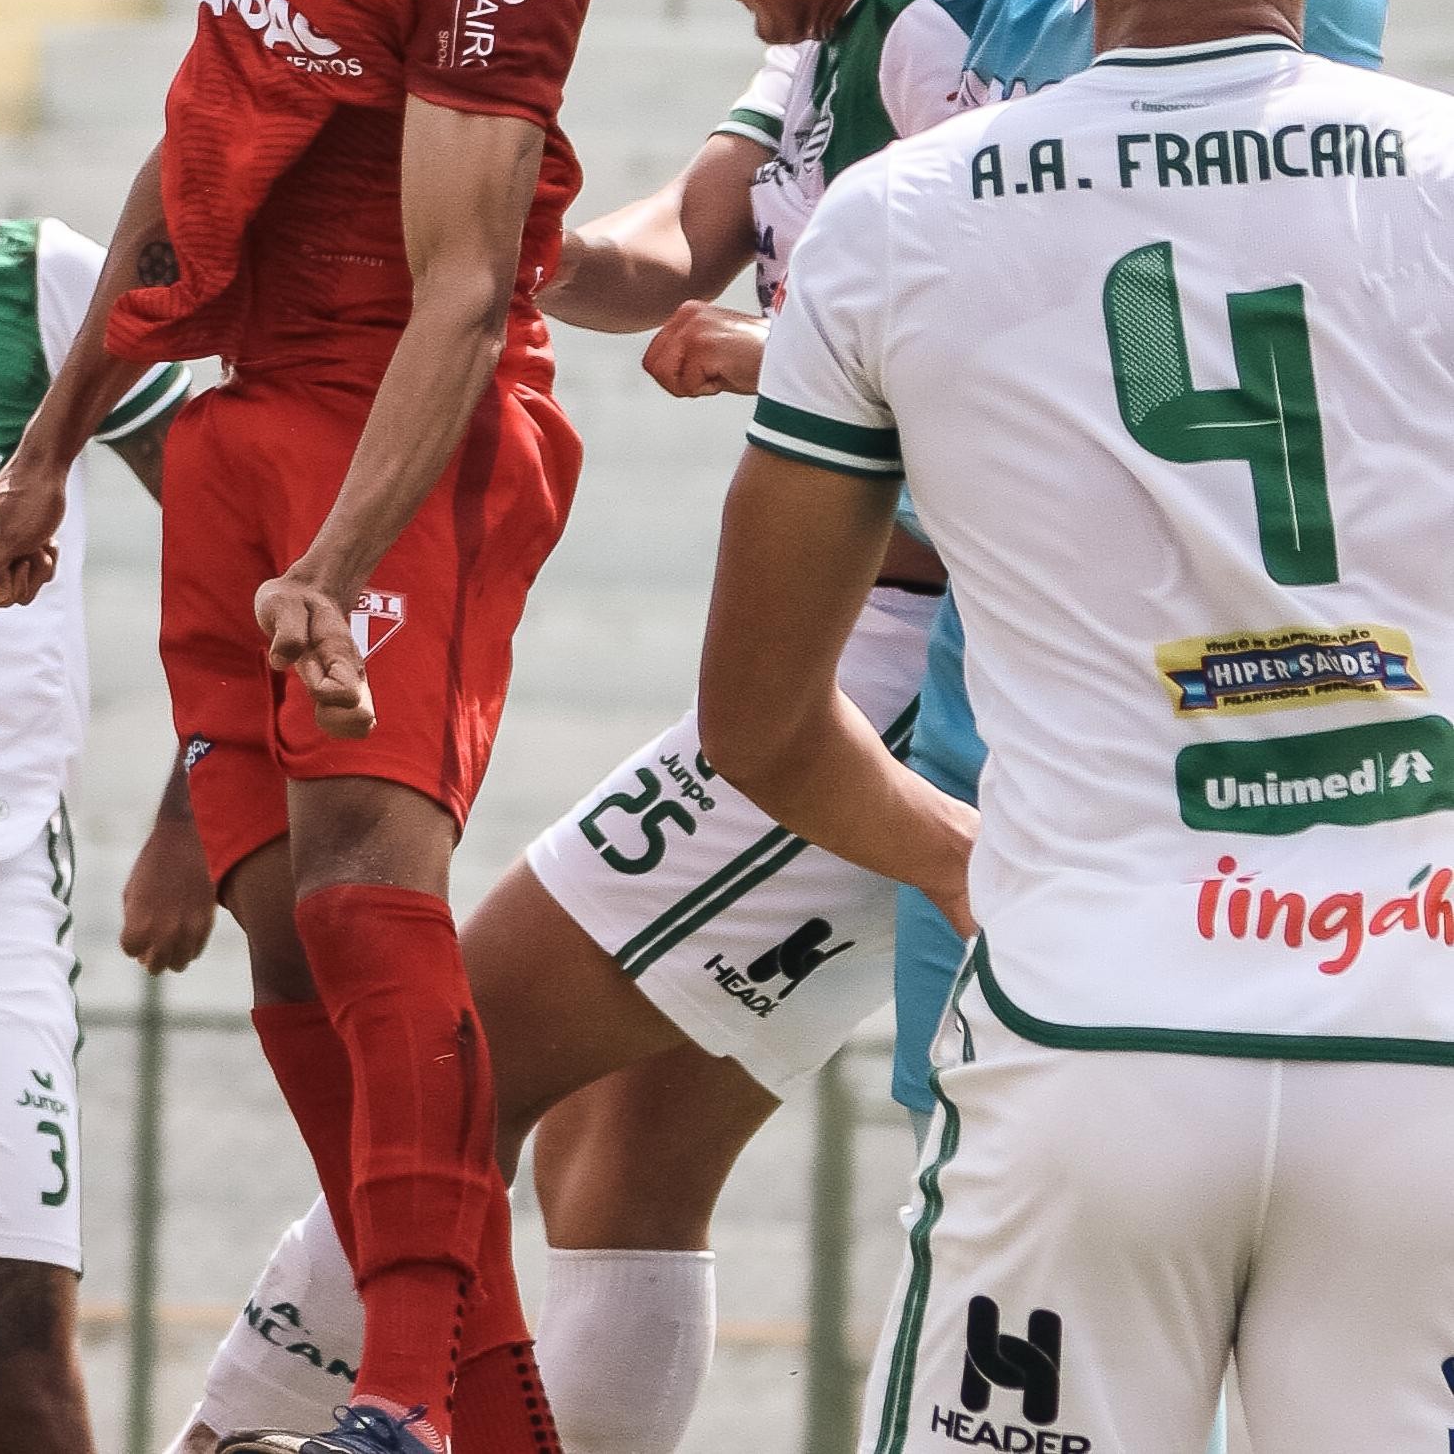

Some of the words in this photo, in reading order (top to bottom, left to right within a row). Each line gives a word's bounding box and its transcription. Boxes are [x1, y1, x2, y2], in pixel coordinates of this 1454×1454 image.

[1117, 124, 1406, 188] FRANCANA
[1104, 241, 1339, 585] 4
[1213, 659, 1292, 687] HIPER
[1205, 759, 1377, 811] Unimed
[579, 767, 696, 875] 25
[37, 1120, 69, 1206] 3
[931, 1404, 1091, 1454] HEADER
